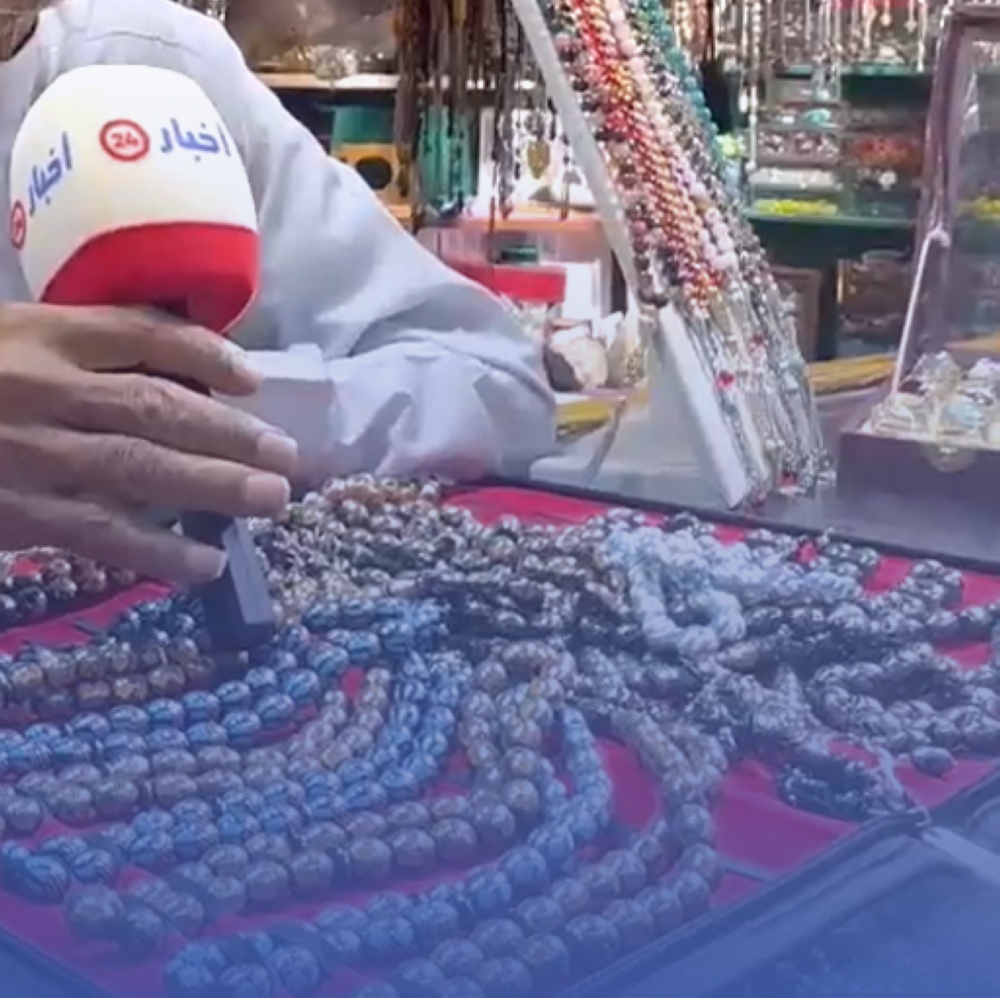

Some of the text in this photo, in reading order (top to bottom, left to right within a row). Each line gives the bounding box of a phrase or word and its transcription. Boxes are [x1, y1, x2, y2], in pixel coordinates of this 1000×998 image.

[109, 117, 231, 162] اخبار 24
[28, 131, 73, 217] اخبار
